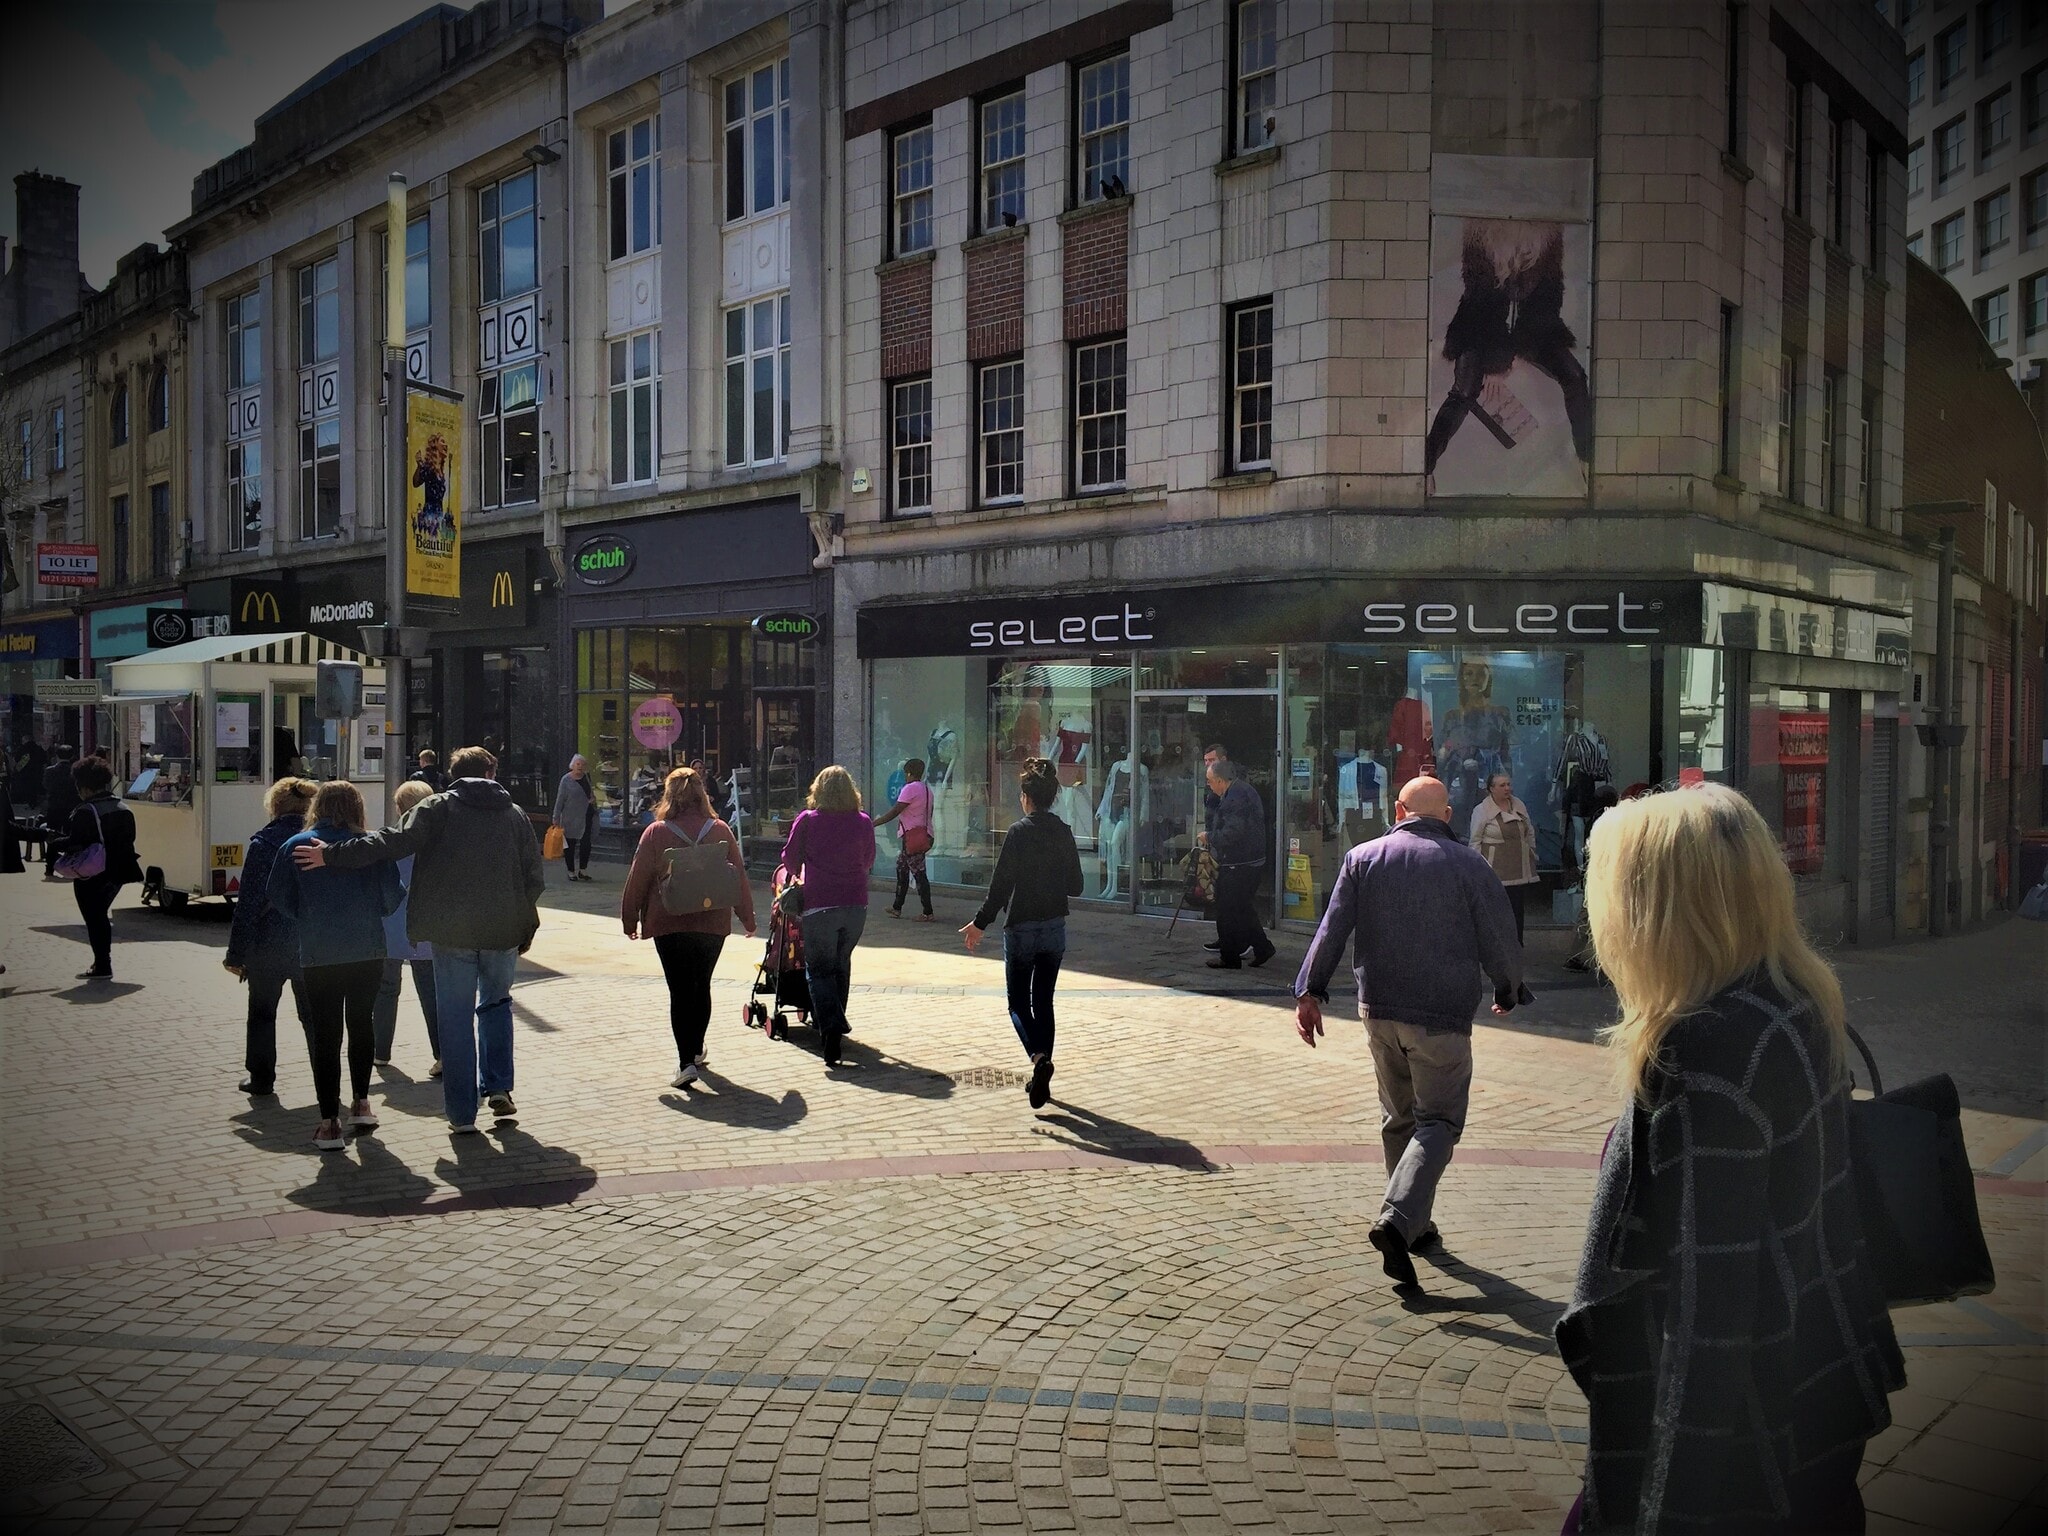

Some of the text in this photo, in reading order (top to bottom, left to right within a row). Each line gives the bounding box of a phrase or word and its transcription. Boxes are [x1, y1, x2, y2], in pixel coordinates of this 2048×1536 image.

[416, 534, 453, 552] Beautiful
[48, 557, 89, 568] TO LET
[581, 546, 625, 570] schuh
[310, 600, 374, 623] McDonald's
[190, 616, 213, 638] THE
[765, 618, 811, 633] schuh
[9, 633, 36, 654] Factory
[1516, 696, 1542, 704] FRILL
[1516, 704, 1557, 712] DRESSES
[215, 845, 239, 856] BW17
[217, 856, 237, 866] XFL
